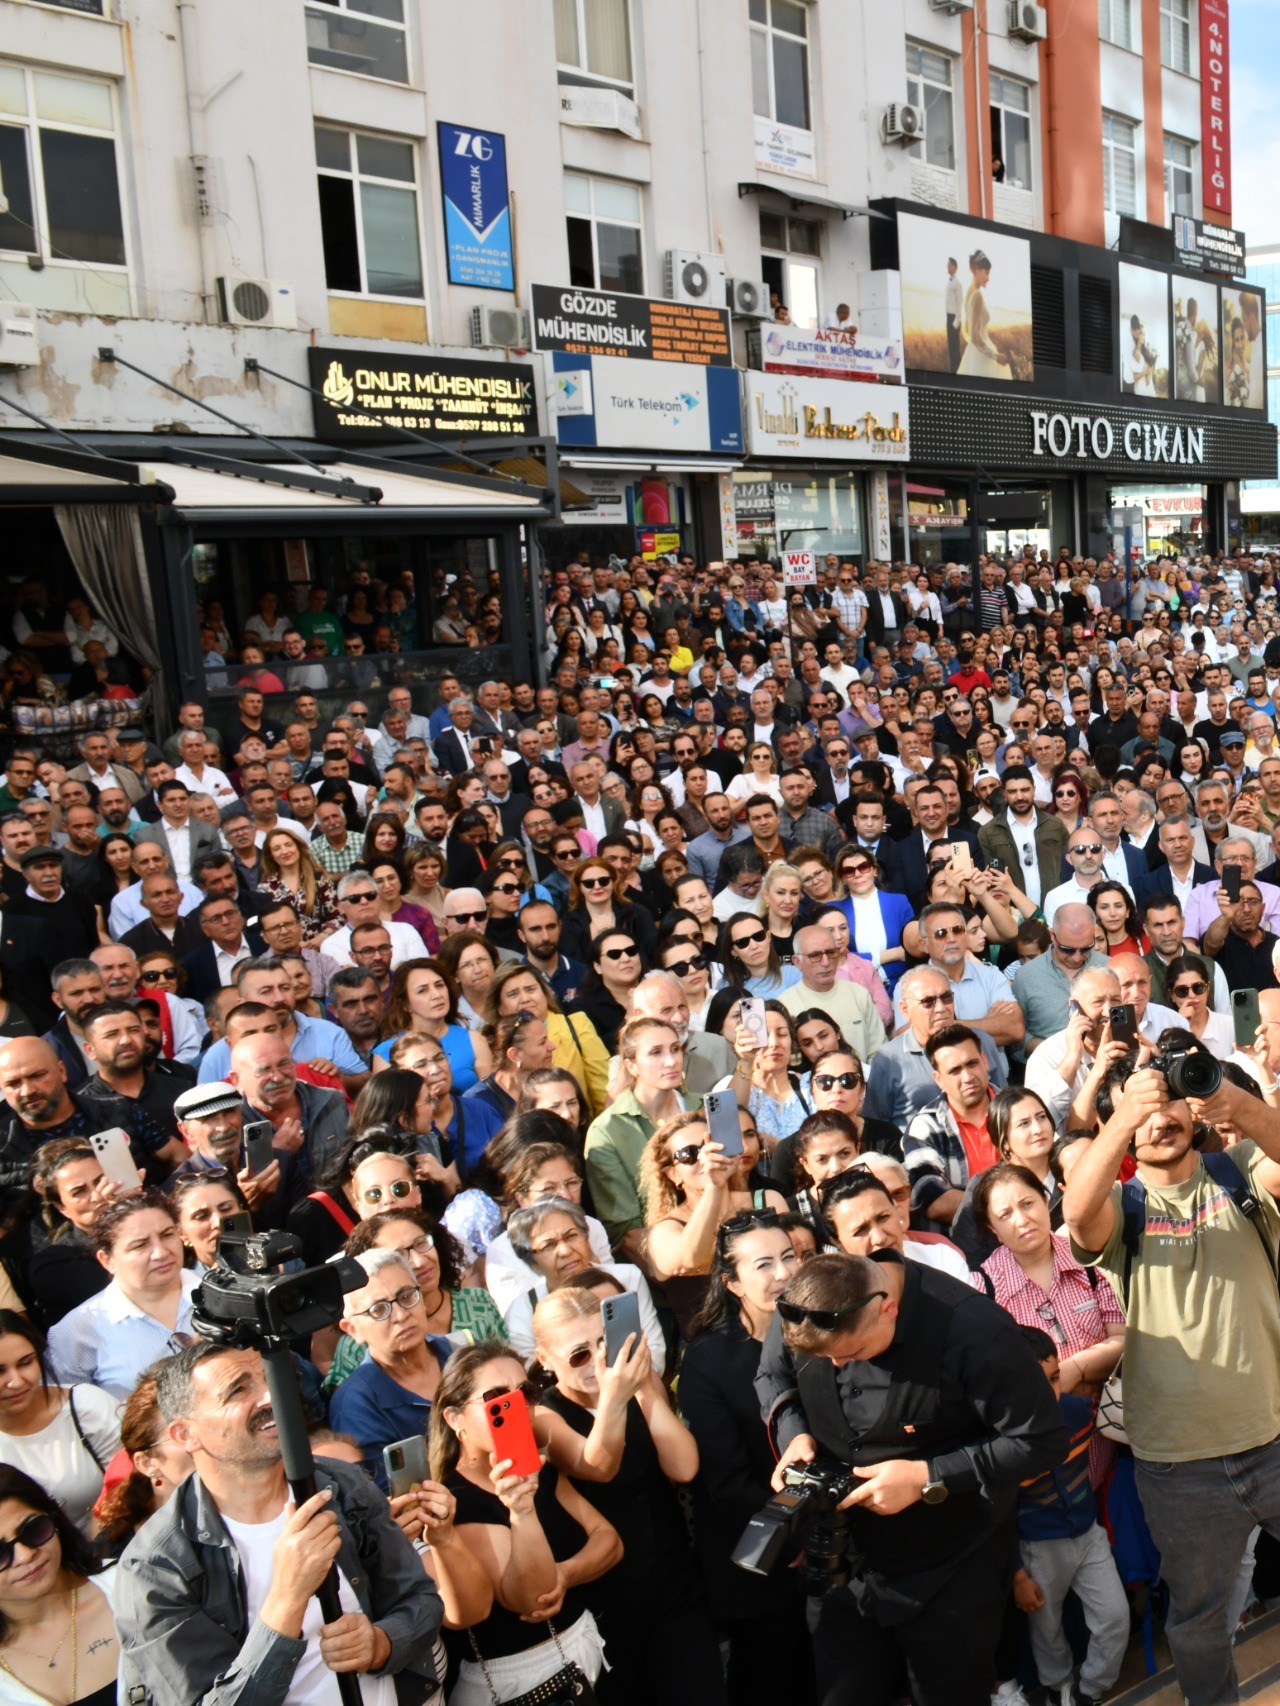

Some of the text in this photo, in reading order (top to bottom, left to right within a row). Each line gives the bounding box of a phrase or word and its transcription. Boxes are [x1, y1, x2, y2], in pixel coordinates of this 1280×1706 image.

[453, 130, 493, 162] ZG
[560, 291, 618, 318] GÖZDE
[538, 316, 648, 348] MÜHENDİSLİK
[815, 330, 857, 347] AKTAŞ
[786, 340, 884, 360] ELEKTRİK MÜHENDİSLİK
[355, 369, 532, 400] ONUR MÜHENDİSLİK
[610, 396, 683, 412] Türk Telekom
[1030, 411, 1114, 459] FOTO
[1152, 497, 1203, 511] EVKUR
[787, 554, 811, 566] WC
[790, 574, 811, 582] BAYAN
